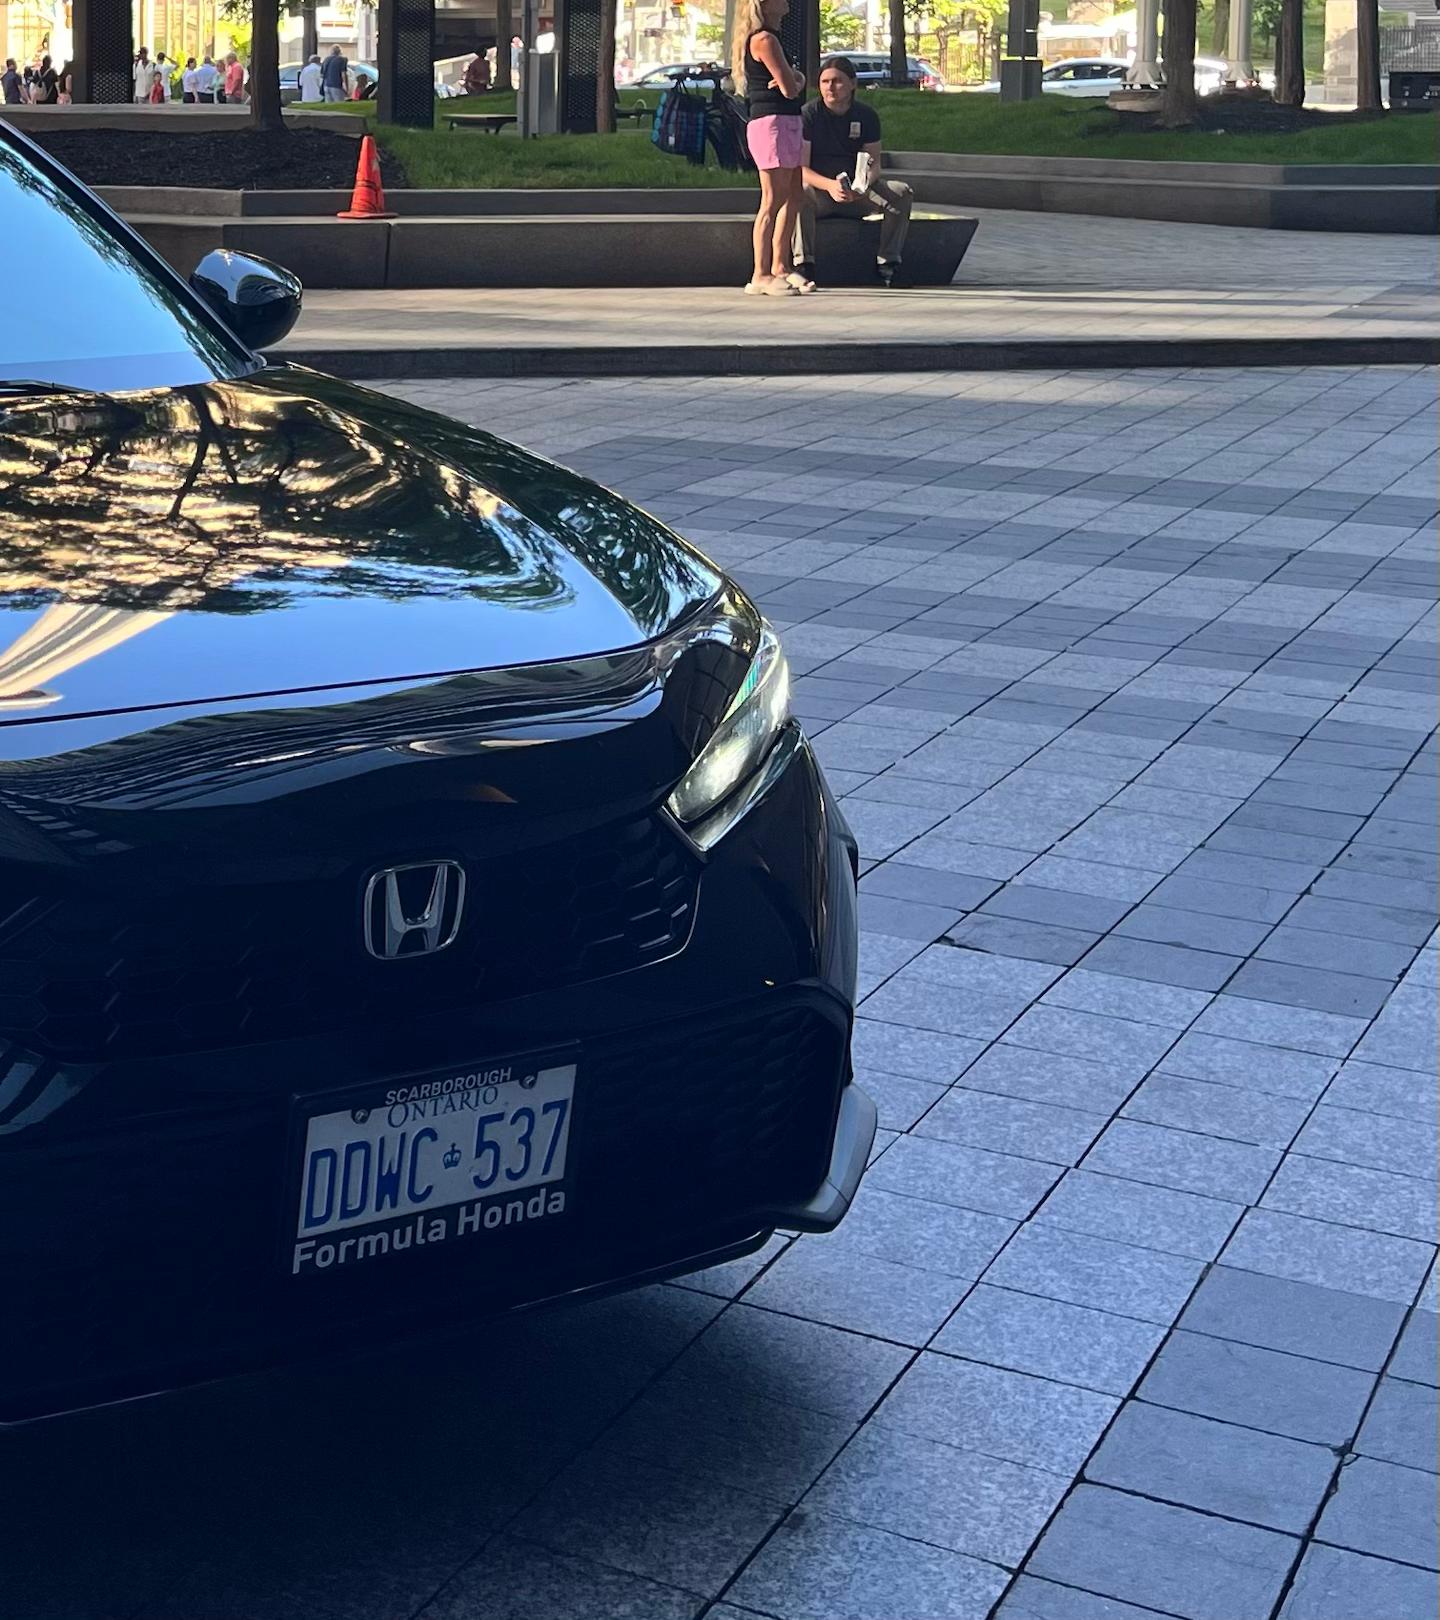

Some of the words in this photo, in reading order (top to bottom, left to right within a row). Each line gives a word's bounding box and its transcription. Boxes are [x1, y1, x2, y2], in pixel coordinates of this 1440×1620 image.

[385, 1067, 511, 1105] SCARBOROUGH
[387, 1086, 498, 1128] ONTARIO
[304, 1127, 438, 1229] DDWC
[472, 1099, 568, 1190] 537
[292, 1214, 447, 1274] Formula
[456, 1188, 565, 1236] Honda
